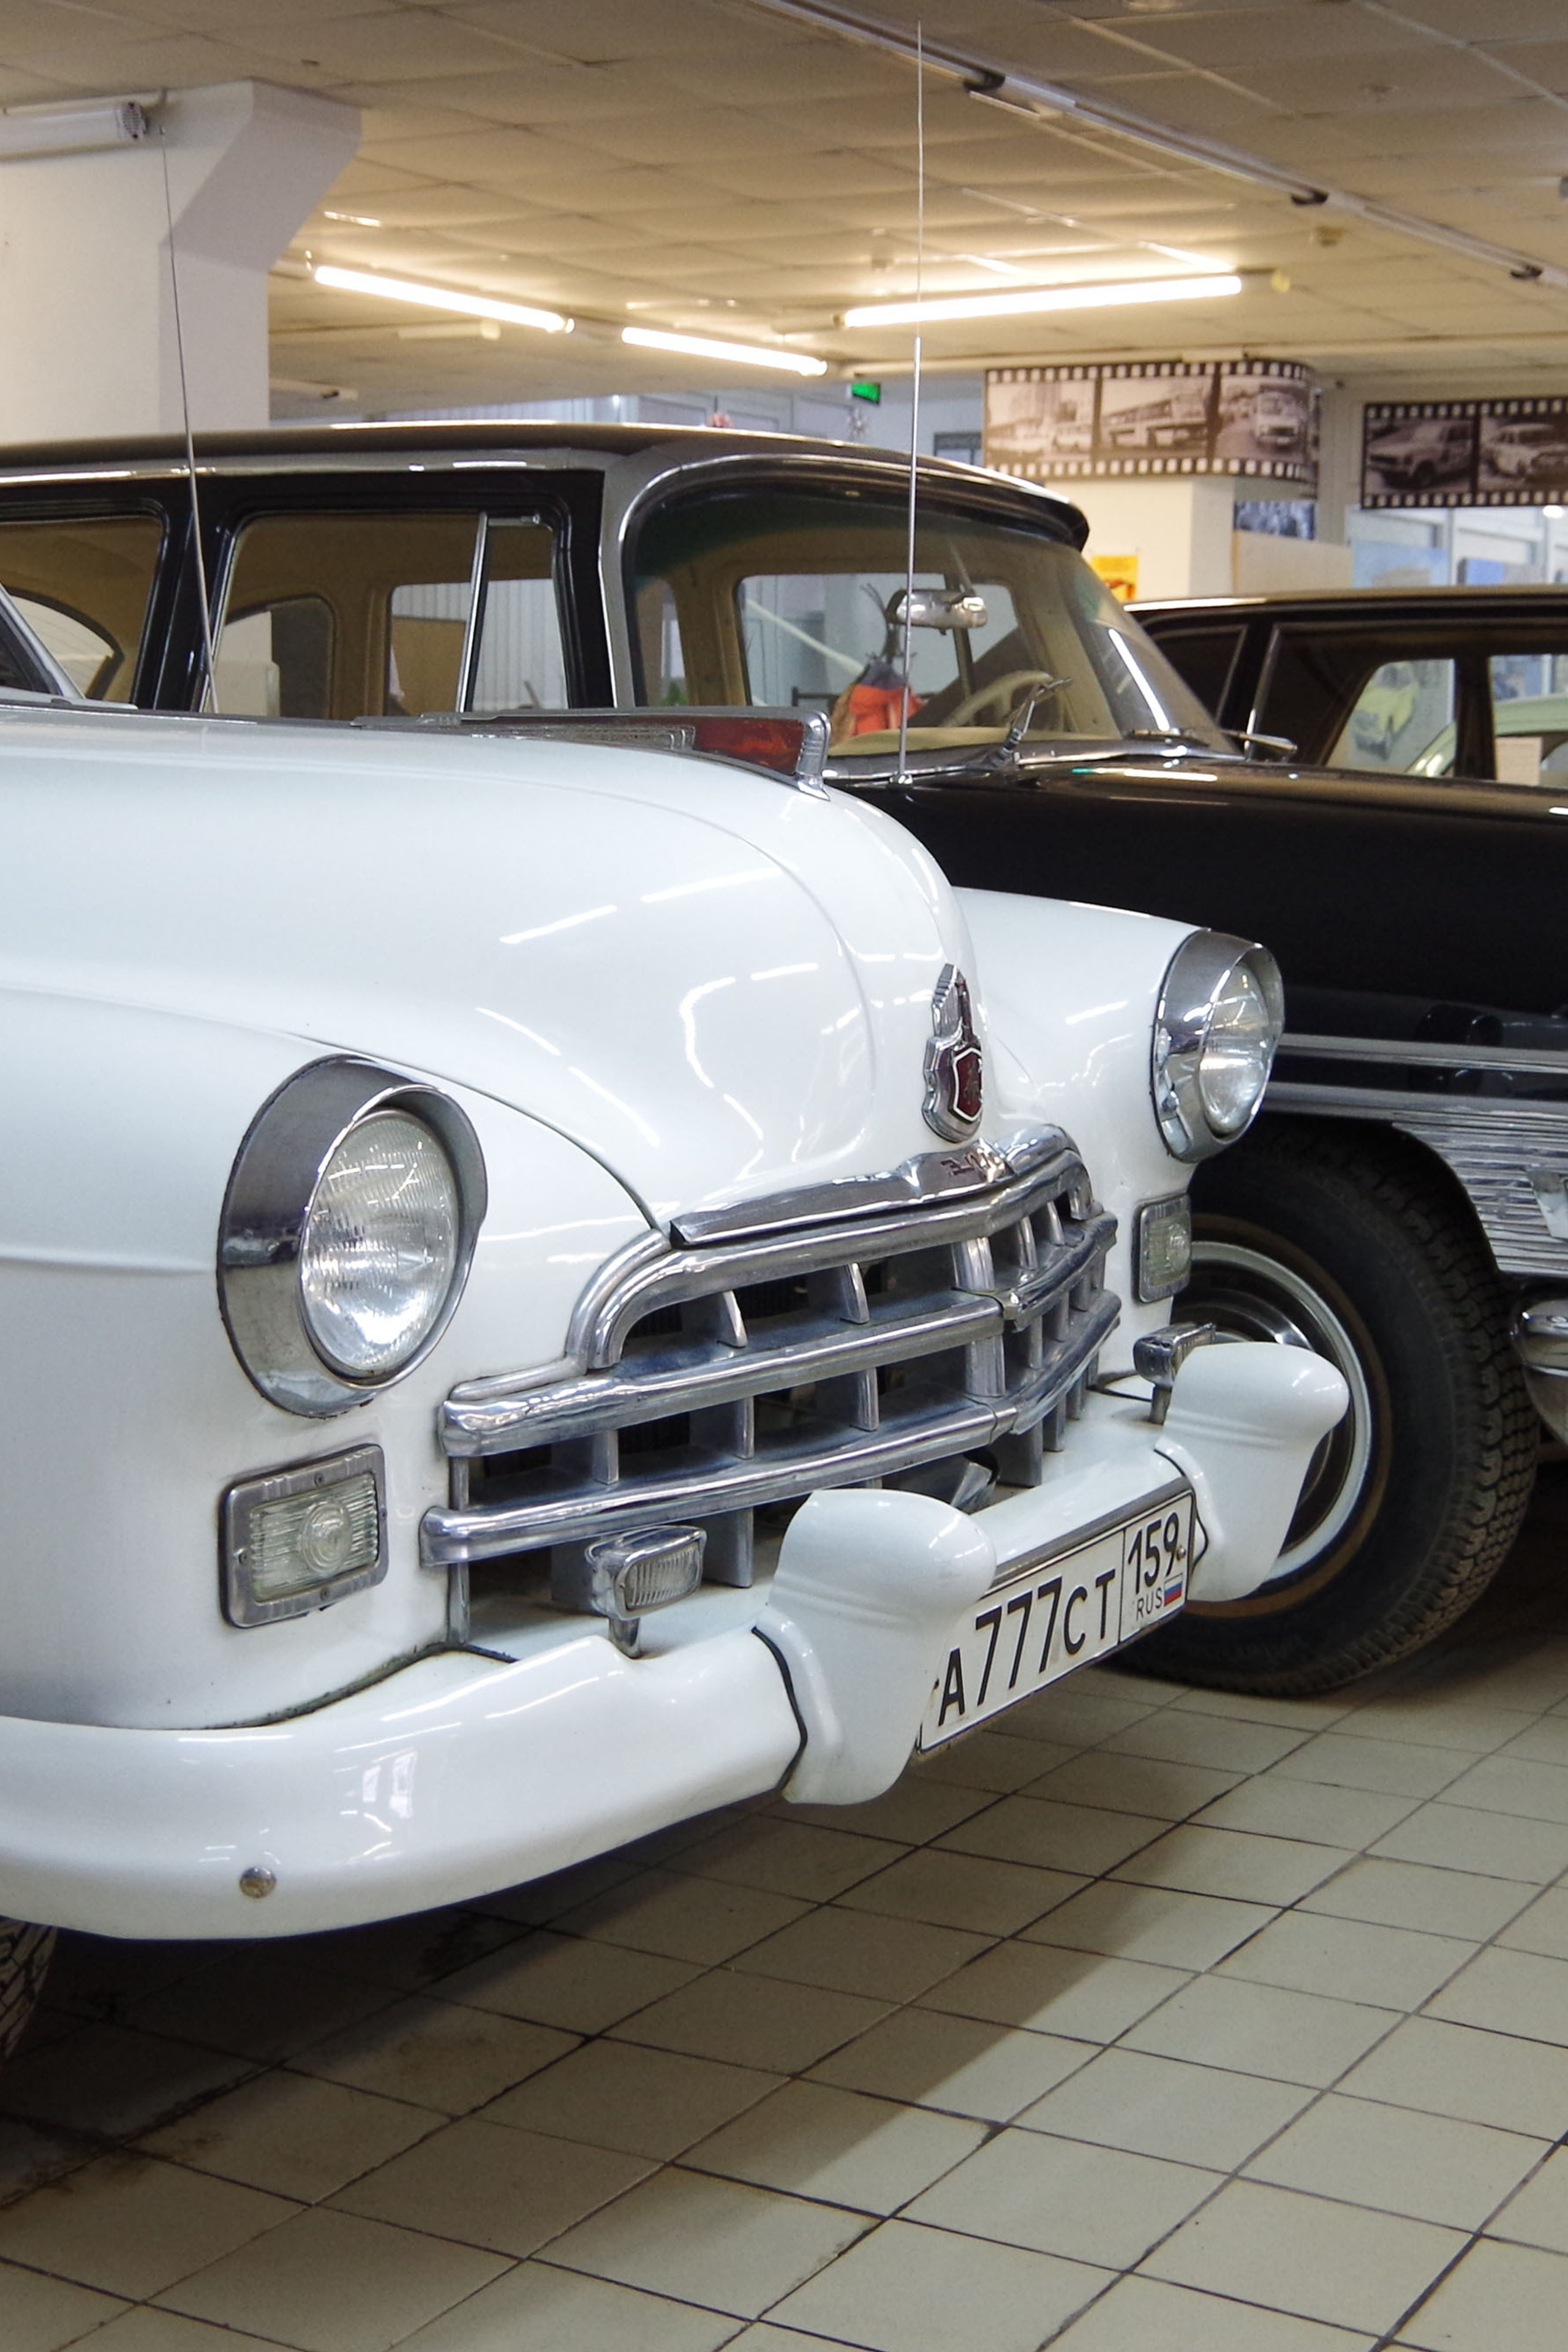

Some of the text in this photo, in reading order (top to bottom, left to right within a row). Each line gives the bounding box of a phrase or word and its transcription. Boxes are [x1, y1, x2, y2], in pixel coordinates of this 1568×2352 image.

[938, 1512, 1179, 1726] A777CT 159
[1136, 1587, 1163, 1621] RUS
